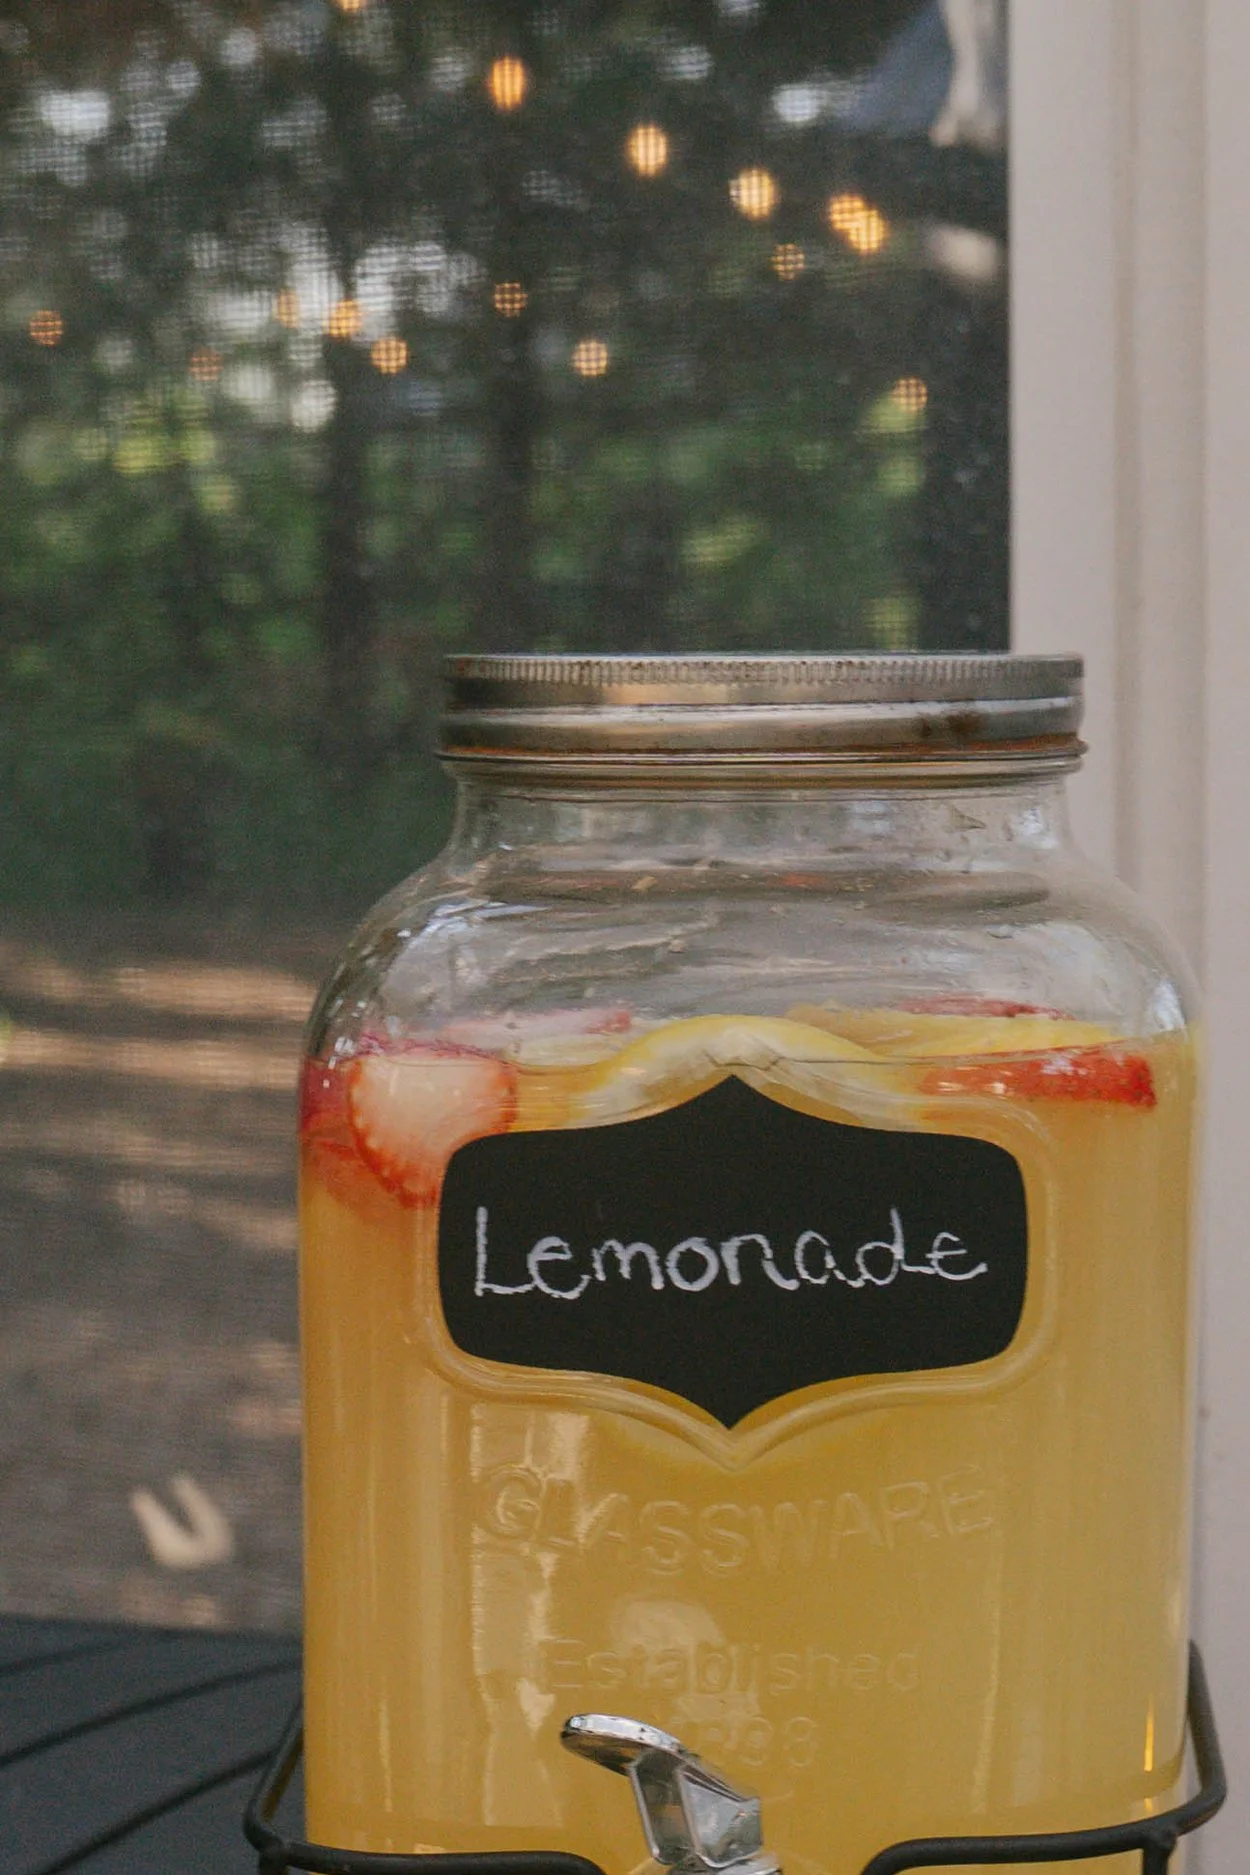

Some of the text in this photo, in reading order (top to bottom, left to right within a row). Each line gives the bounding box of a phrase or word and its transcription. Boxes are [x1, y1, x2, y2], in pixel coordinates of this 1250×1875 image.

[474, 1205, 989, 1300] Lemonade
[485, 1463, 994, 1576] GLASSWARE
[545, 1639, 922, 1696] Established
